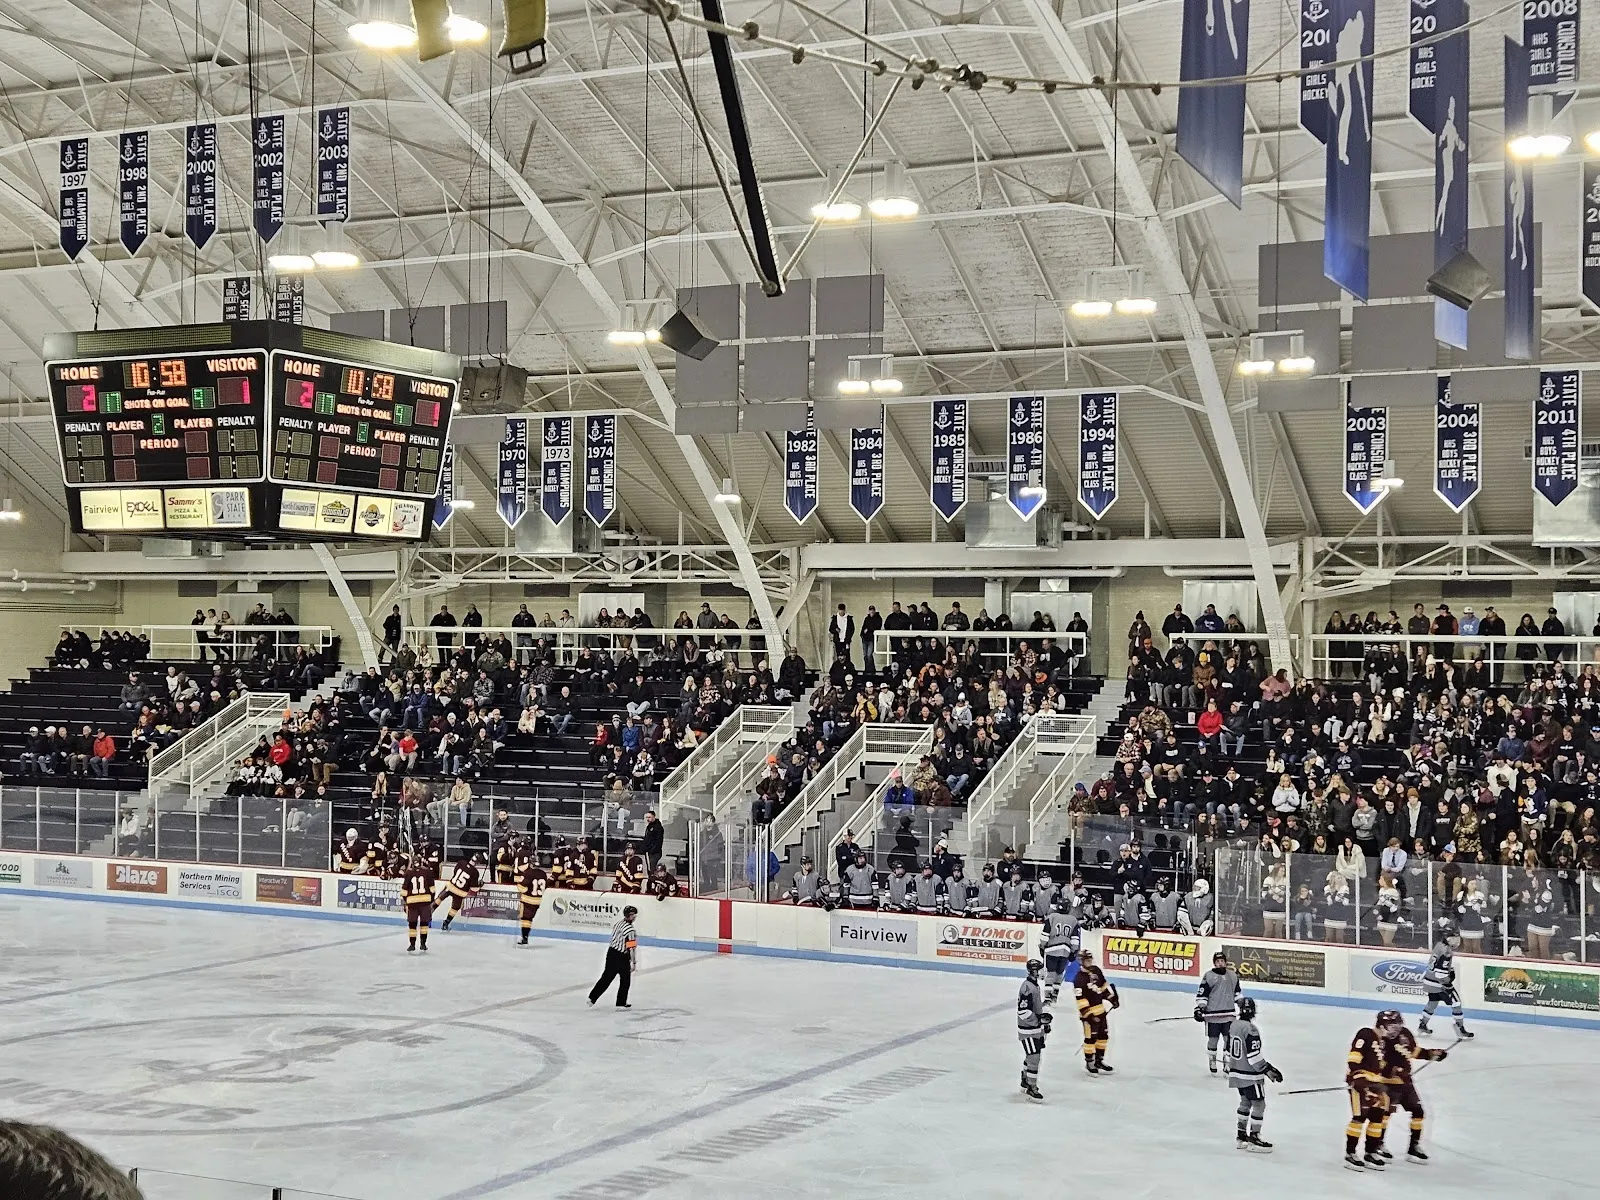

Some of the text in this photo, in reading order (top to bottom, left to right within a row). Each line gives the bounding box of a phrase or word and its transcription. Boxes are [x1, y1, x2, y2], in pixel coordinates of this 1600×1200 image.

[1524, 0, 1578, 20] 2008
[1415, 61, 1436, 74] GIRLS
[1306, 74, 1327, 86] GIRLS
[1411, 75, 1436, 89] HOCKE
[1302, 89, 1329, 101] HOCKEY
[272, 119, 284, 149] STATE
[337, 112, 348, 142] STATE
[136, 135, 147, 164] STATE
[204, 127, 215, 156] STATE
[77, 142, 87, 170] STATE
[318, 145, 348, 161] 2003
[120, 167, 147, 182] 1998
[186, 160, 216, 176] 2000
[61, 174, 86, 188] 1997
[336, 163, 347, 215] 2ND PLACE
[204, 176, 214, 226] 4TH PLACE
[270, 171, 283, 224] 2ND PLACE
[76, 191, 87, 242] CHAMPIONS
[136, 185, 147, 236] 2ND PLACE
[206, 357, 258, 372] VISITOR
[284, 360, 321, 378] HOME
[60, 366, 99, 380] HOME
[131, 359, 187, 388] 10:58
[411, 380, 449, 398] VISITOR
[1562, 375, 1577, 407] STATE
[82, 384, 96, 412] 2
[124, 397, 190, 410] SHOTS ON GOAL
[336, 404, 392, 420] SHOTS ON GOAL
[953, 404, 965, 432] STATE
[1030, 400, 1042, 428] STATE
[1102, 396, 1115, 426] STATE
[1538, 410, 1576, 424] 2011
[65, 422, 101, 432] PENALTY
[106, 420, 144, 431] PLAYER
[173, 418, 214, 428] PLAYER
[217, 416, 255, 426] PENALTY
[279, 416, 313, 430] PENALTY
[318, 422, 352, 436] PLAYER
[1347, 418, 1386, 432] 2003
[1438, 414, 1479, 428] 2004
[374, 430, 406, 443] PLAYER
[516, 422, 526, 448] STATE
[560, 420, 570, 445] STATE
[603, 418, 614, 444] STATE
[1010, 431, 1042, 444] 1986
[1082, 428, 1116, 442] 1994
[140, 438, 179, 449] PERIOD
[409, 434, 439, 447] PENALTY
[788, 440, 816, 452] 1982
[852, 438, 882, 450] 1984
[934, 434, 965, 447] 1985
[344, 445, 376, 457] PERIOD
[500, 449, 526, 462] 1970
[544, 448, 570, 460] 1973
[588, 446, 614, 458] 1974
[1462, 432, 1477, 483] 3RD PLACE
[1562, 429, 1577, 481] 4TH PLACE
[871, 453, 882, 498] 3RD PLACE
[952, 448, 964, 503] CONSOLATION
[1102, 444, 1114, 492] 2ND PLACE
[516, 463, 526, 504] 3RD PLACE
[560, 462, 570, 508] CHAMPIONS
[602, 460, 614, 510] CONSOLATION
[804, 455, 816, 499] 3RD PLACE
[168, 497, 203, 506] Sammy's
[226, 492, 245, 501] PARK
[442, 484, 452, 506] PLACE
[84, 504, 119, 514] Fairview
[227, 503, 246, 512] STATE
[116, 866, 158, 886] Blaze
[179, 871, 240, 884] Northern Mining
[452, 868, 471, 888] 15
[180, 882, 212, 891] Services
[216, 889, 240, 897] ISCO
[411, 876, 426, 894] 11
[531, 878, 546, 896] 13
[464, 897, 485, 910] JAMES
[568, 900, 622, 916] Security
[840, 926, 908, 943] Fairview
[962, 926, 1026, 940] TROMCO
[1055, 922, 1072, 937] 10
[962, 939, 1016, 949] ELECTRIC
[1106, 938, 1198, 957] KITZVILLE
[1108, 954, 1148, 967] BODY
[1154, 956, 1194, 972] SHOP
[1384, 963, 1424, 984] Ford
[1392, 986, 1428, 996] HIBBIN
[1484, 978, 1546, 996] Fortune Bay
[1251, 1040, 1260, 1050] 20
